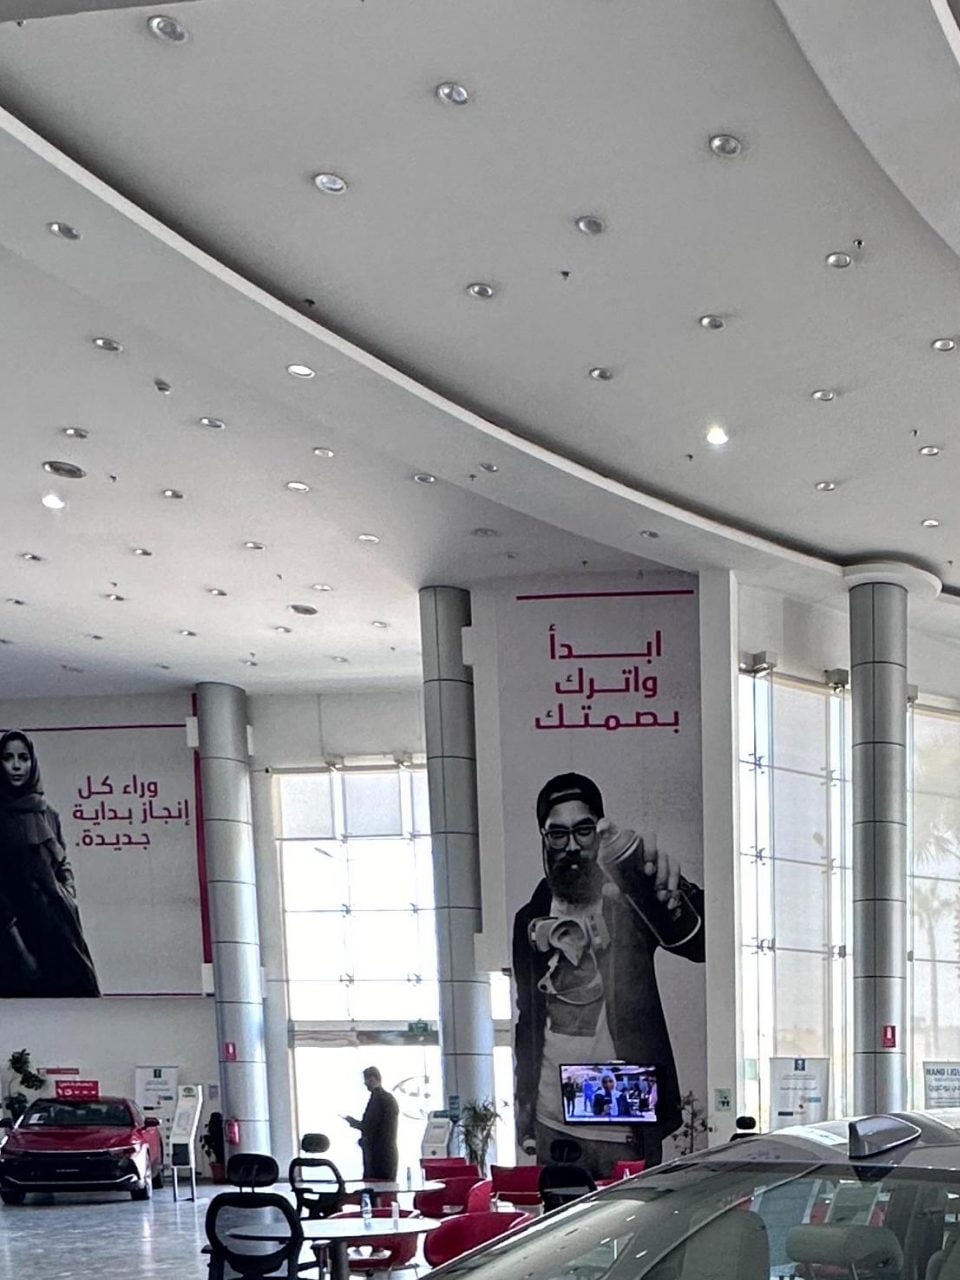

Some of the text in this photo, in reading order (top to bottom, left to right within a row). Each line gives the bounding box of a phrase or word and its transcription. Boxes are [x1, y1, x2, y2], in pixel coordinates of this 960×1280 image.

[549, 624, 662, 664] ابدأ
[555, 666, 658, 700] واترك
[535, 703, 680, 734] بصمتك
[78, 774, 158, 799] وراء كل
[73, 799, 190, 826] إنجاز بداية
